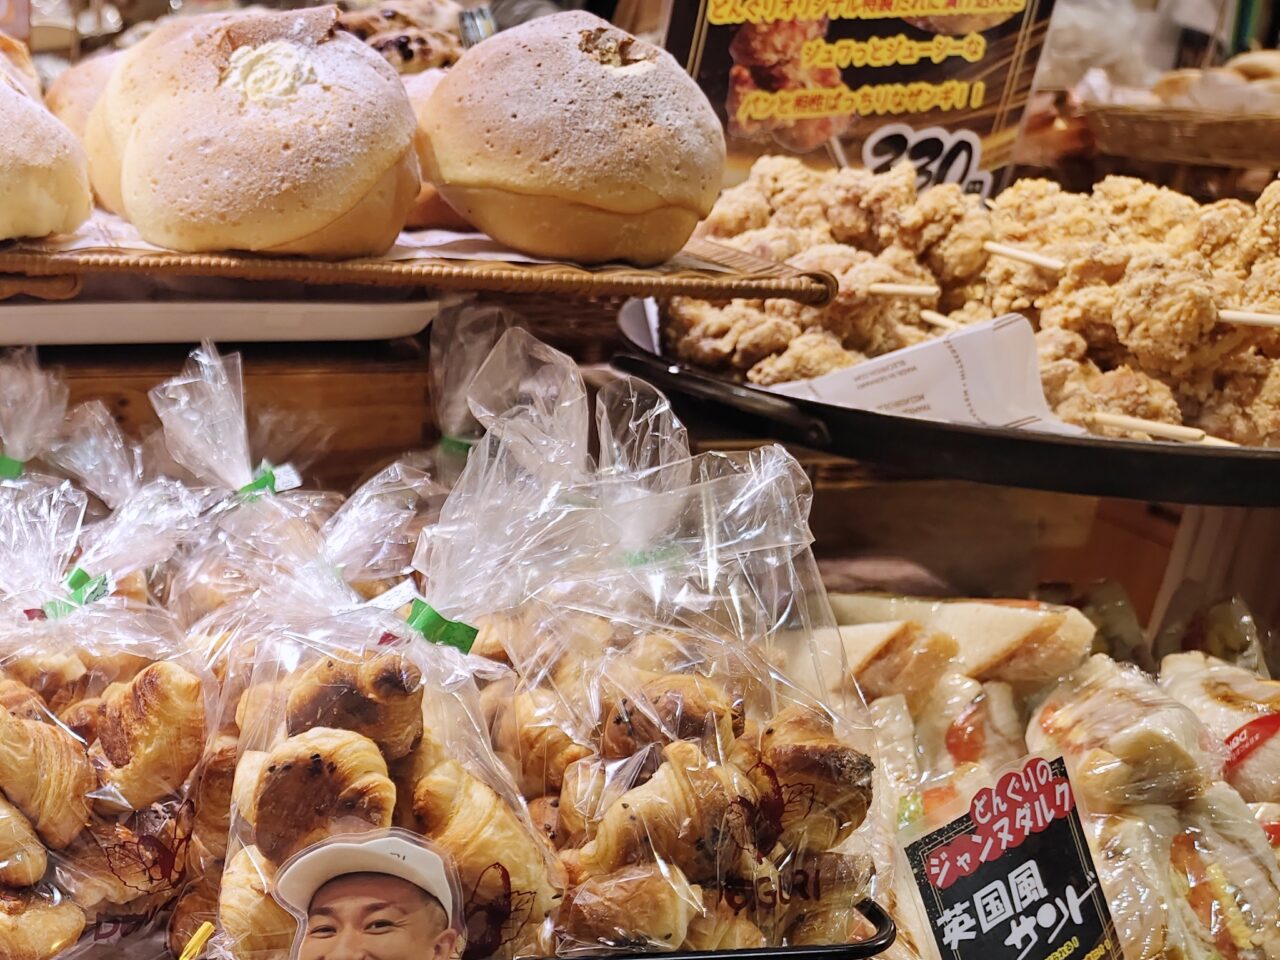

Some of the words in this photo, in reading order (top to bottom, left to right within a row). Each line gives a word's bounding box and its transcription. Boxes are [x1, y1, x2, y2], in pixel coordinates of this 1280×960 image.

[928, 782, 1074, 888] ジャンヌダルク
[972, 758, 1053, 825] どんぐりの
[936, 858, 1050, 951] 英国風
